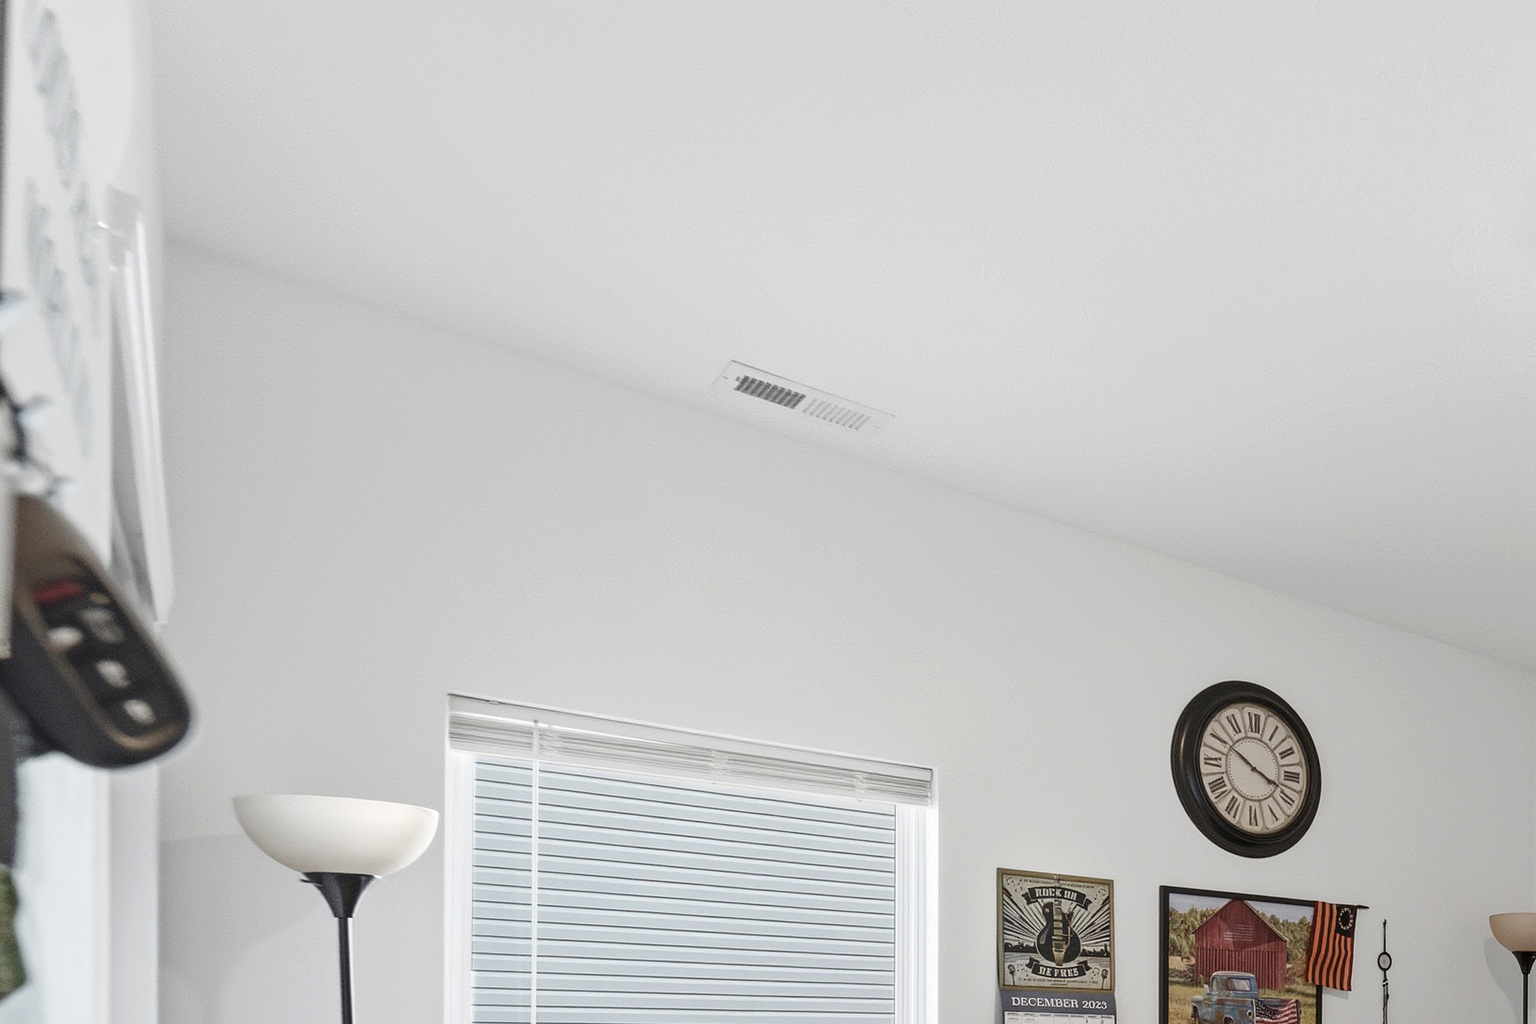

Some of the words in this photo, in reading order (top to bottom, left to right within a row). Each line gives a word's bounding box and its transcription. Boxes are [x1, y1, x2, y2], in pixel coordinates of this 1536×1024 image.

[1248, 712, 1260, 734] XII
[1279, 747, 1295, 759] II
[1284, 770, 1300, 783] III
[1011, 997, 1079, 1009] DECEMBER
[1082, 1000, 1107, 1010] 2023
